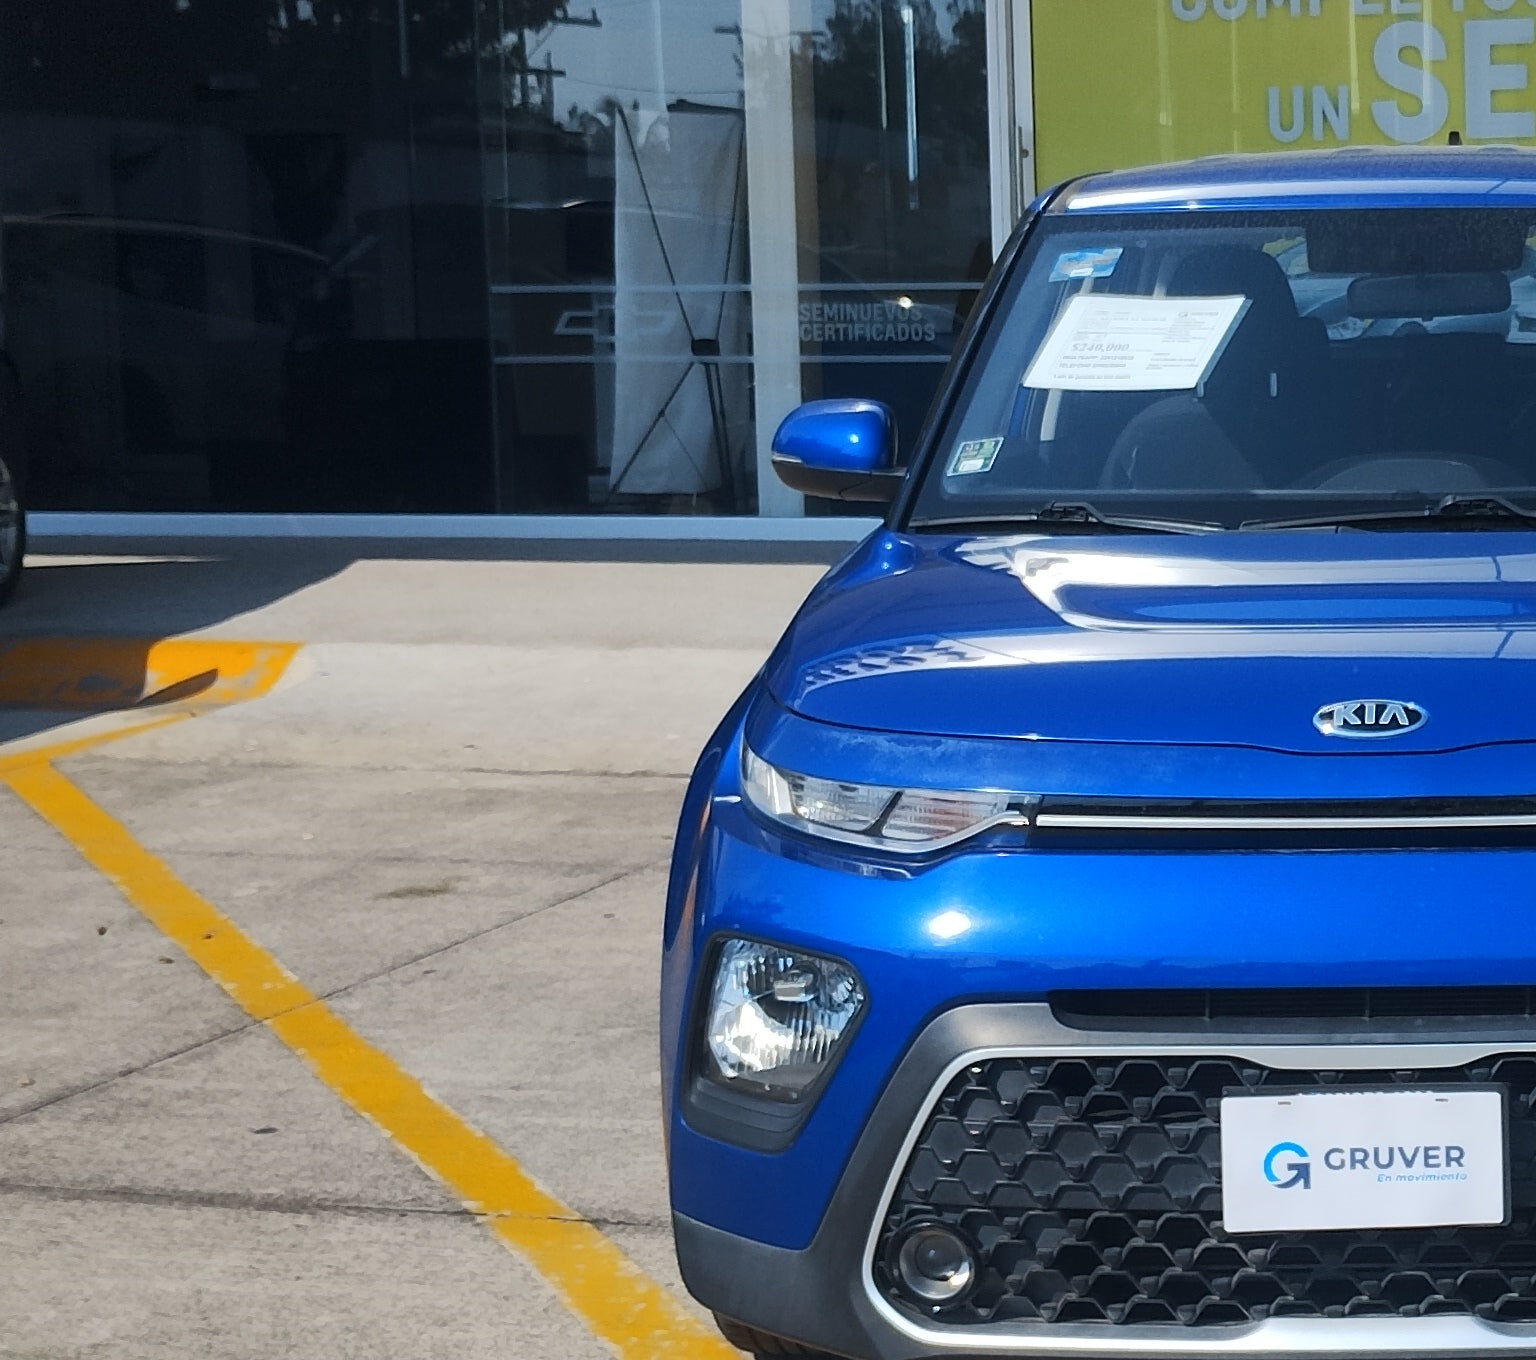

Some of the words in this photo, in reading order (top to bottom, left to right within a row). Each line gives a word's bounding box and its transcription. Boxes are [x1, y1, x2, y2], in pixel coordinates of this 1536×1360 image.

[1267, 84, 1350, 142] UN
[800, 302, 923, 322] SEMINUEVOS
[800, 322, 936, 342] CERTIFICADOS
[1333, 703, 1410, 726] KIA
[1324, 1145, 1466, 1171] GRUVER
[1377, 1173, 1392, 1183] En
[1396, 1172, 1468, 1182] movimiento
